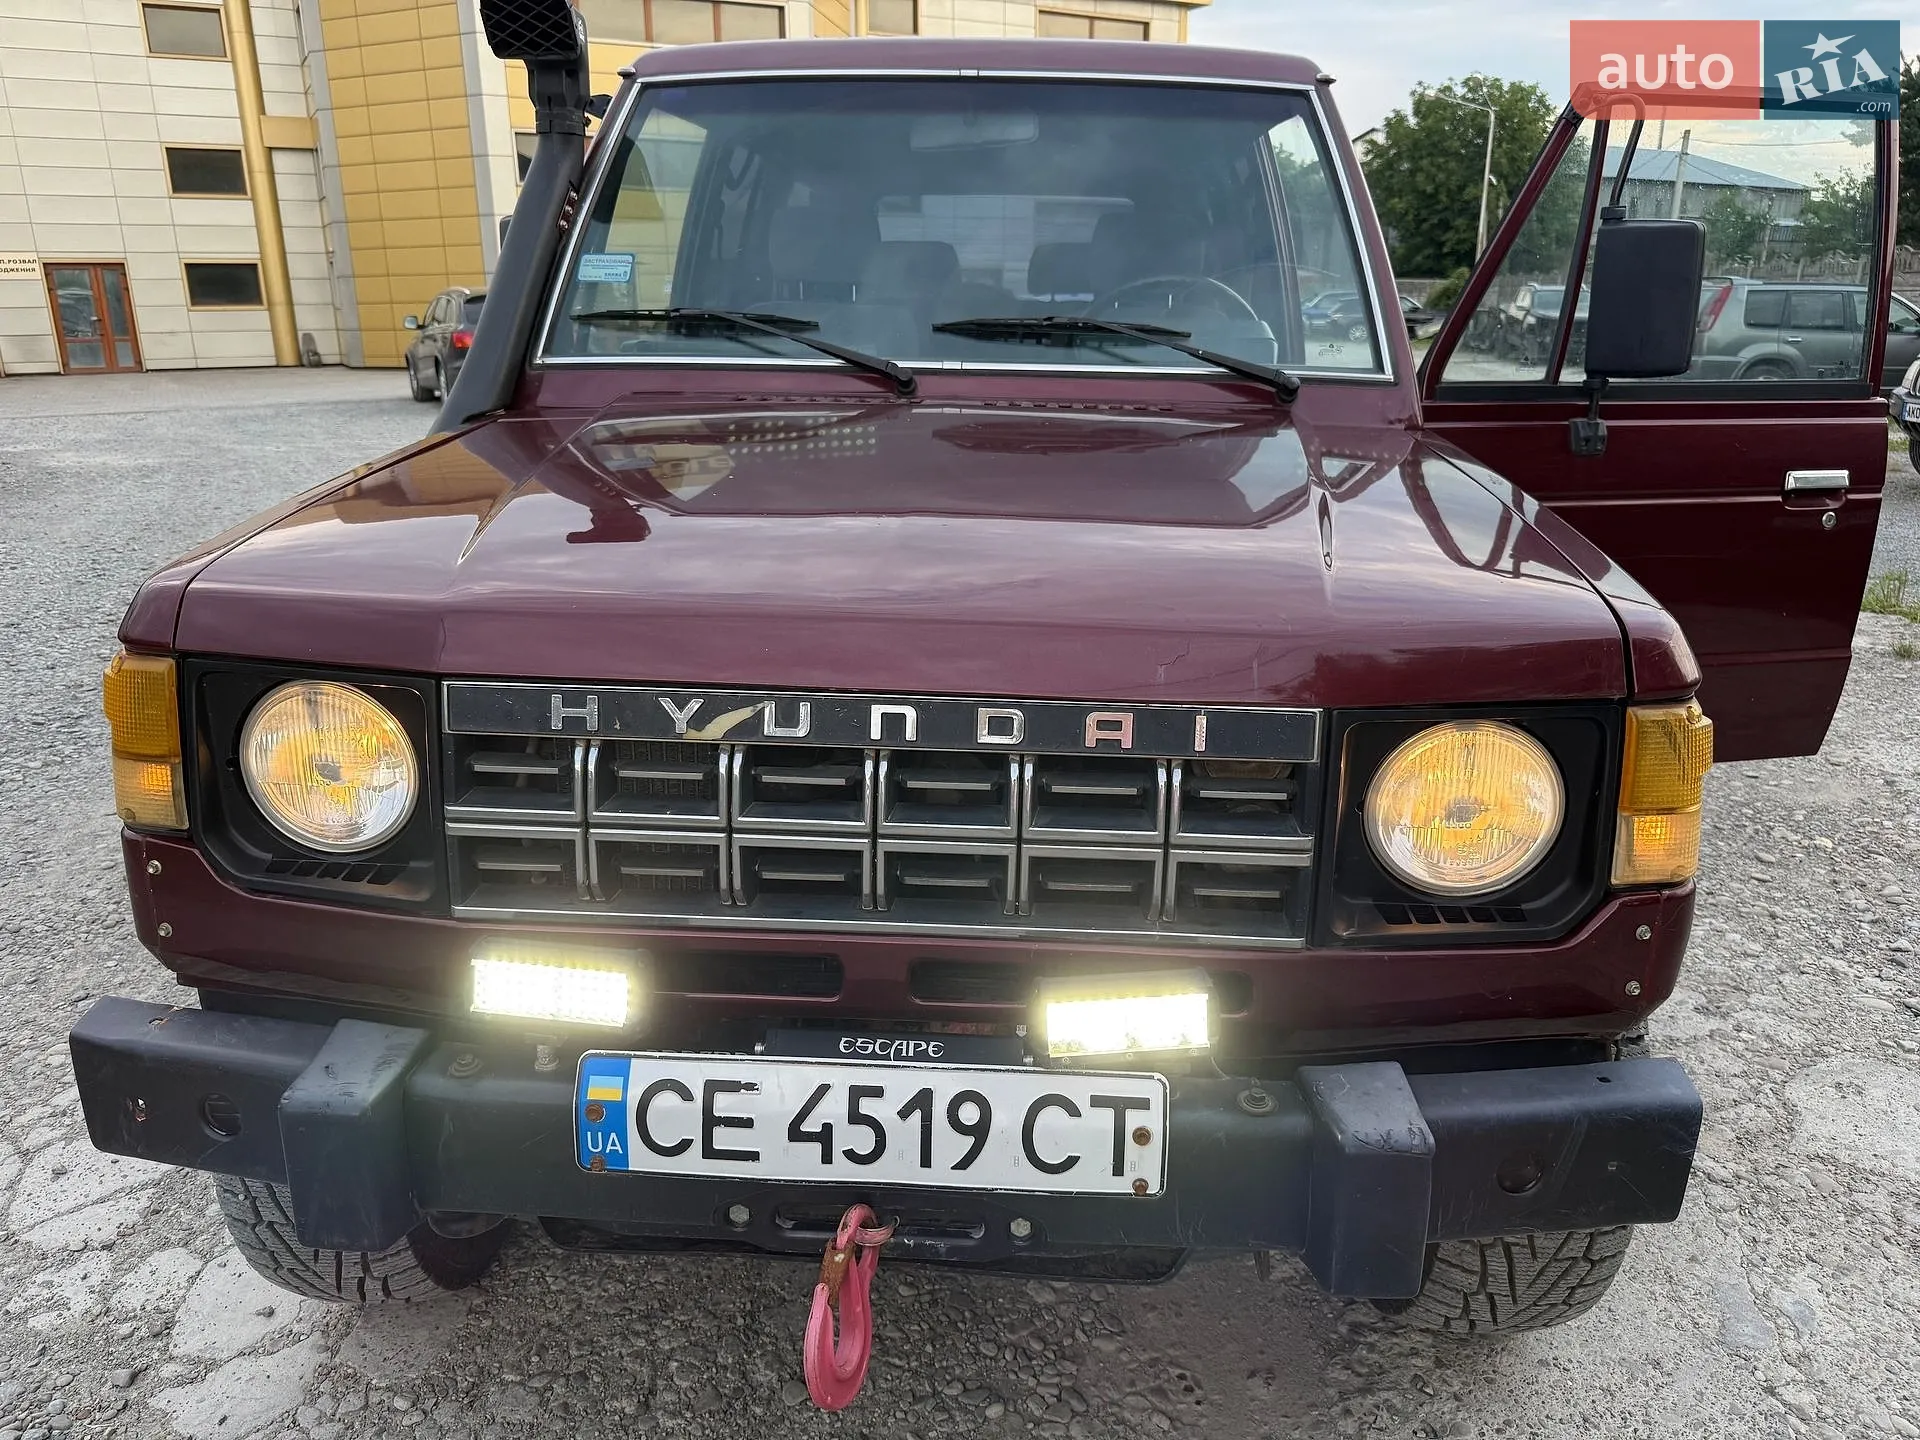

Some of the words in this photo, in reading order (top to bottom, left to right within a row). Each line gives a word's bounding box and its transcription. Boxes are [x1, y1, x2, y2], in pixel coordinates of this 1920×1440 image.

[551, 694, 1207, 751] HYUNDAI
[839, 1037, 945, 1061] ESCAPE
[587, 1132, 623, 1154] UA
[636, 1078, 760, 1162] CE
[787, 1083, 992, 1170] 4519
[1021, 1093, 1151, 1177] CT
